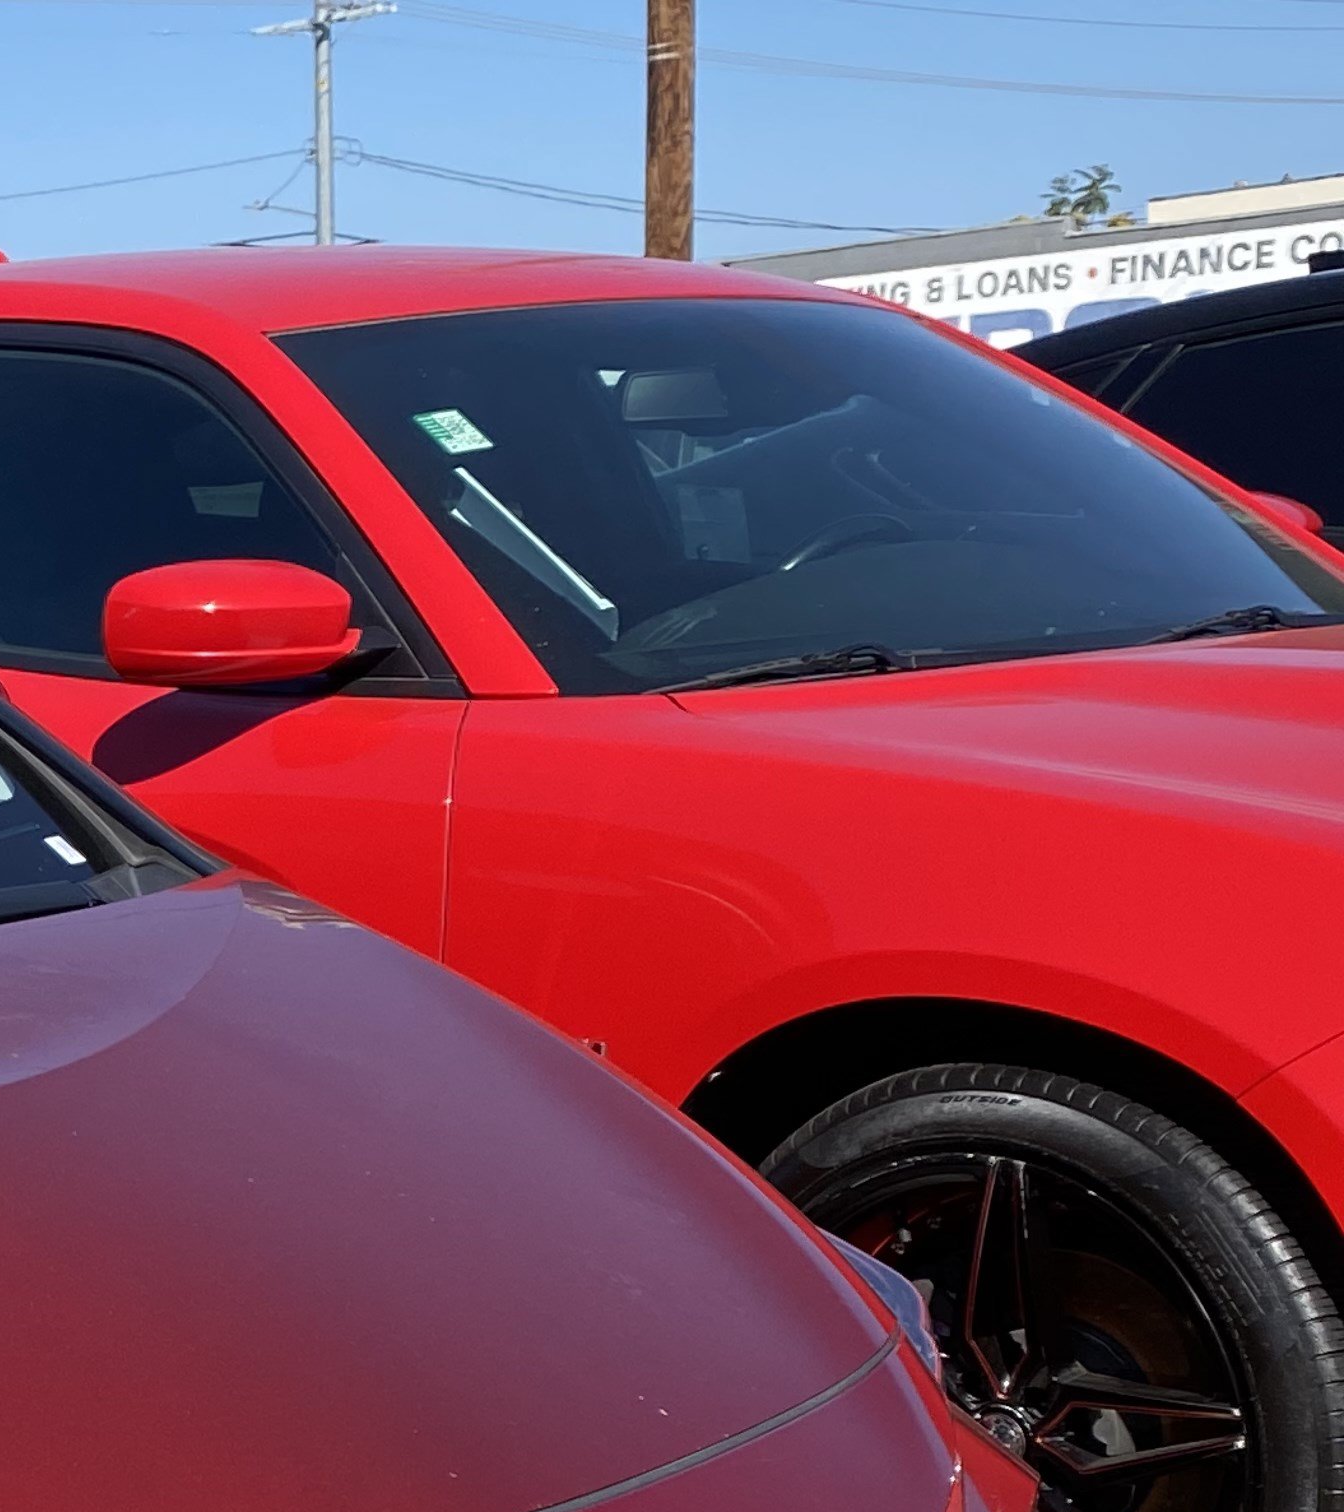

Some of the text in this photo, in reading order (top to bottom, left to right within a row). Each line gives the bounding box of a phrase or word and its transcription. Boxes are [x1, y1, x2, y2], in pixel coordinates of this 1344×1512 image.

[926, 276, 944, 303] &
[957, 262, 1073, 301] LOANS
[1110, 239, 1276, 286] FINANCE
[938, 1094, 1023, 1107] OUTSIDE
